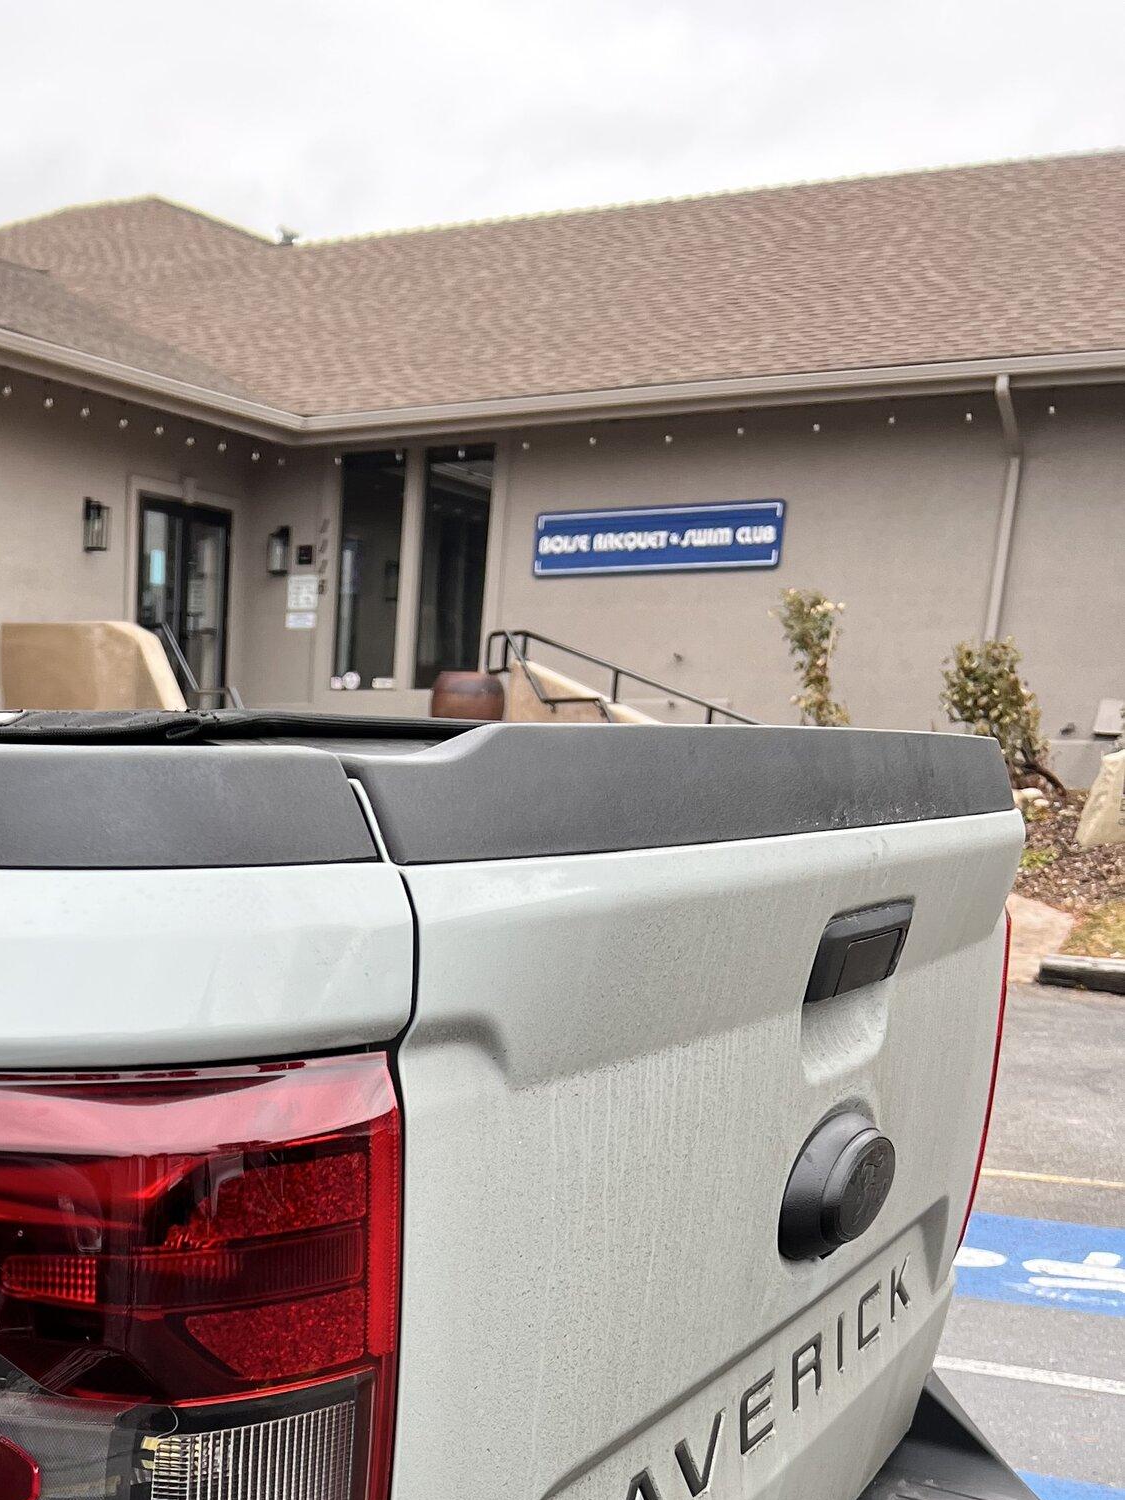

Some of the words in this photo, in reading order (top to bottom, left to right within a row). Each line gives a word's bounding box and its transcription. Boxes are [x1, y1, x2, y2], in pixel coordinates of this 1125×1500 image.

[538, 533, 591, 555] BOISE
[593, 530, 669, 552] RACQUET
[680, 526, 733, 548] SWIM
[735, 524, 777, 545] CLUB
